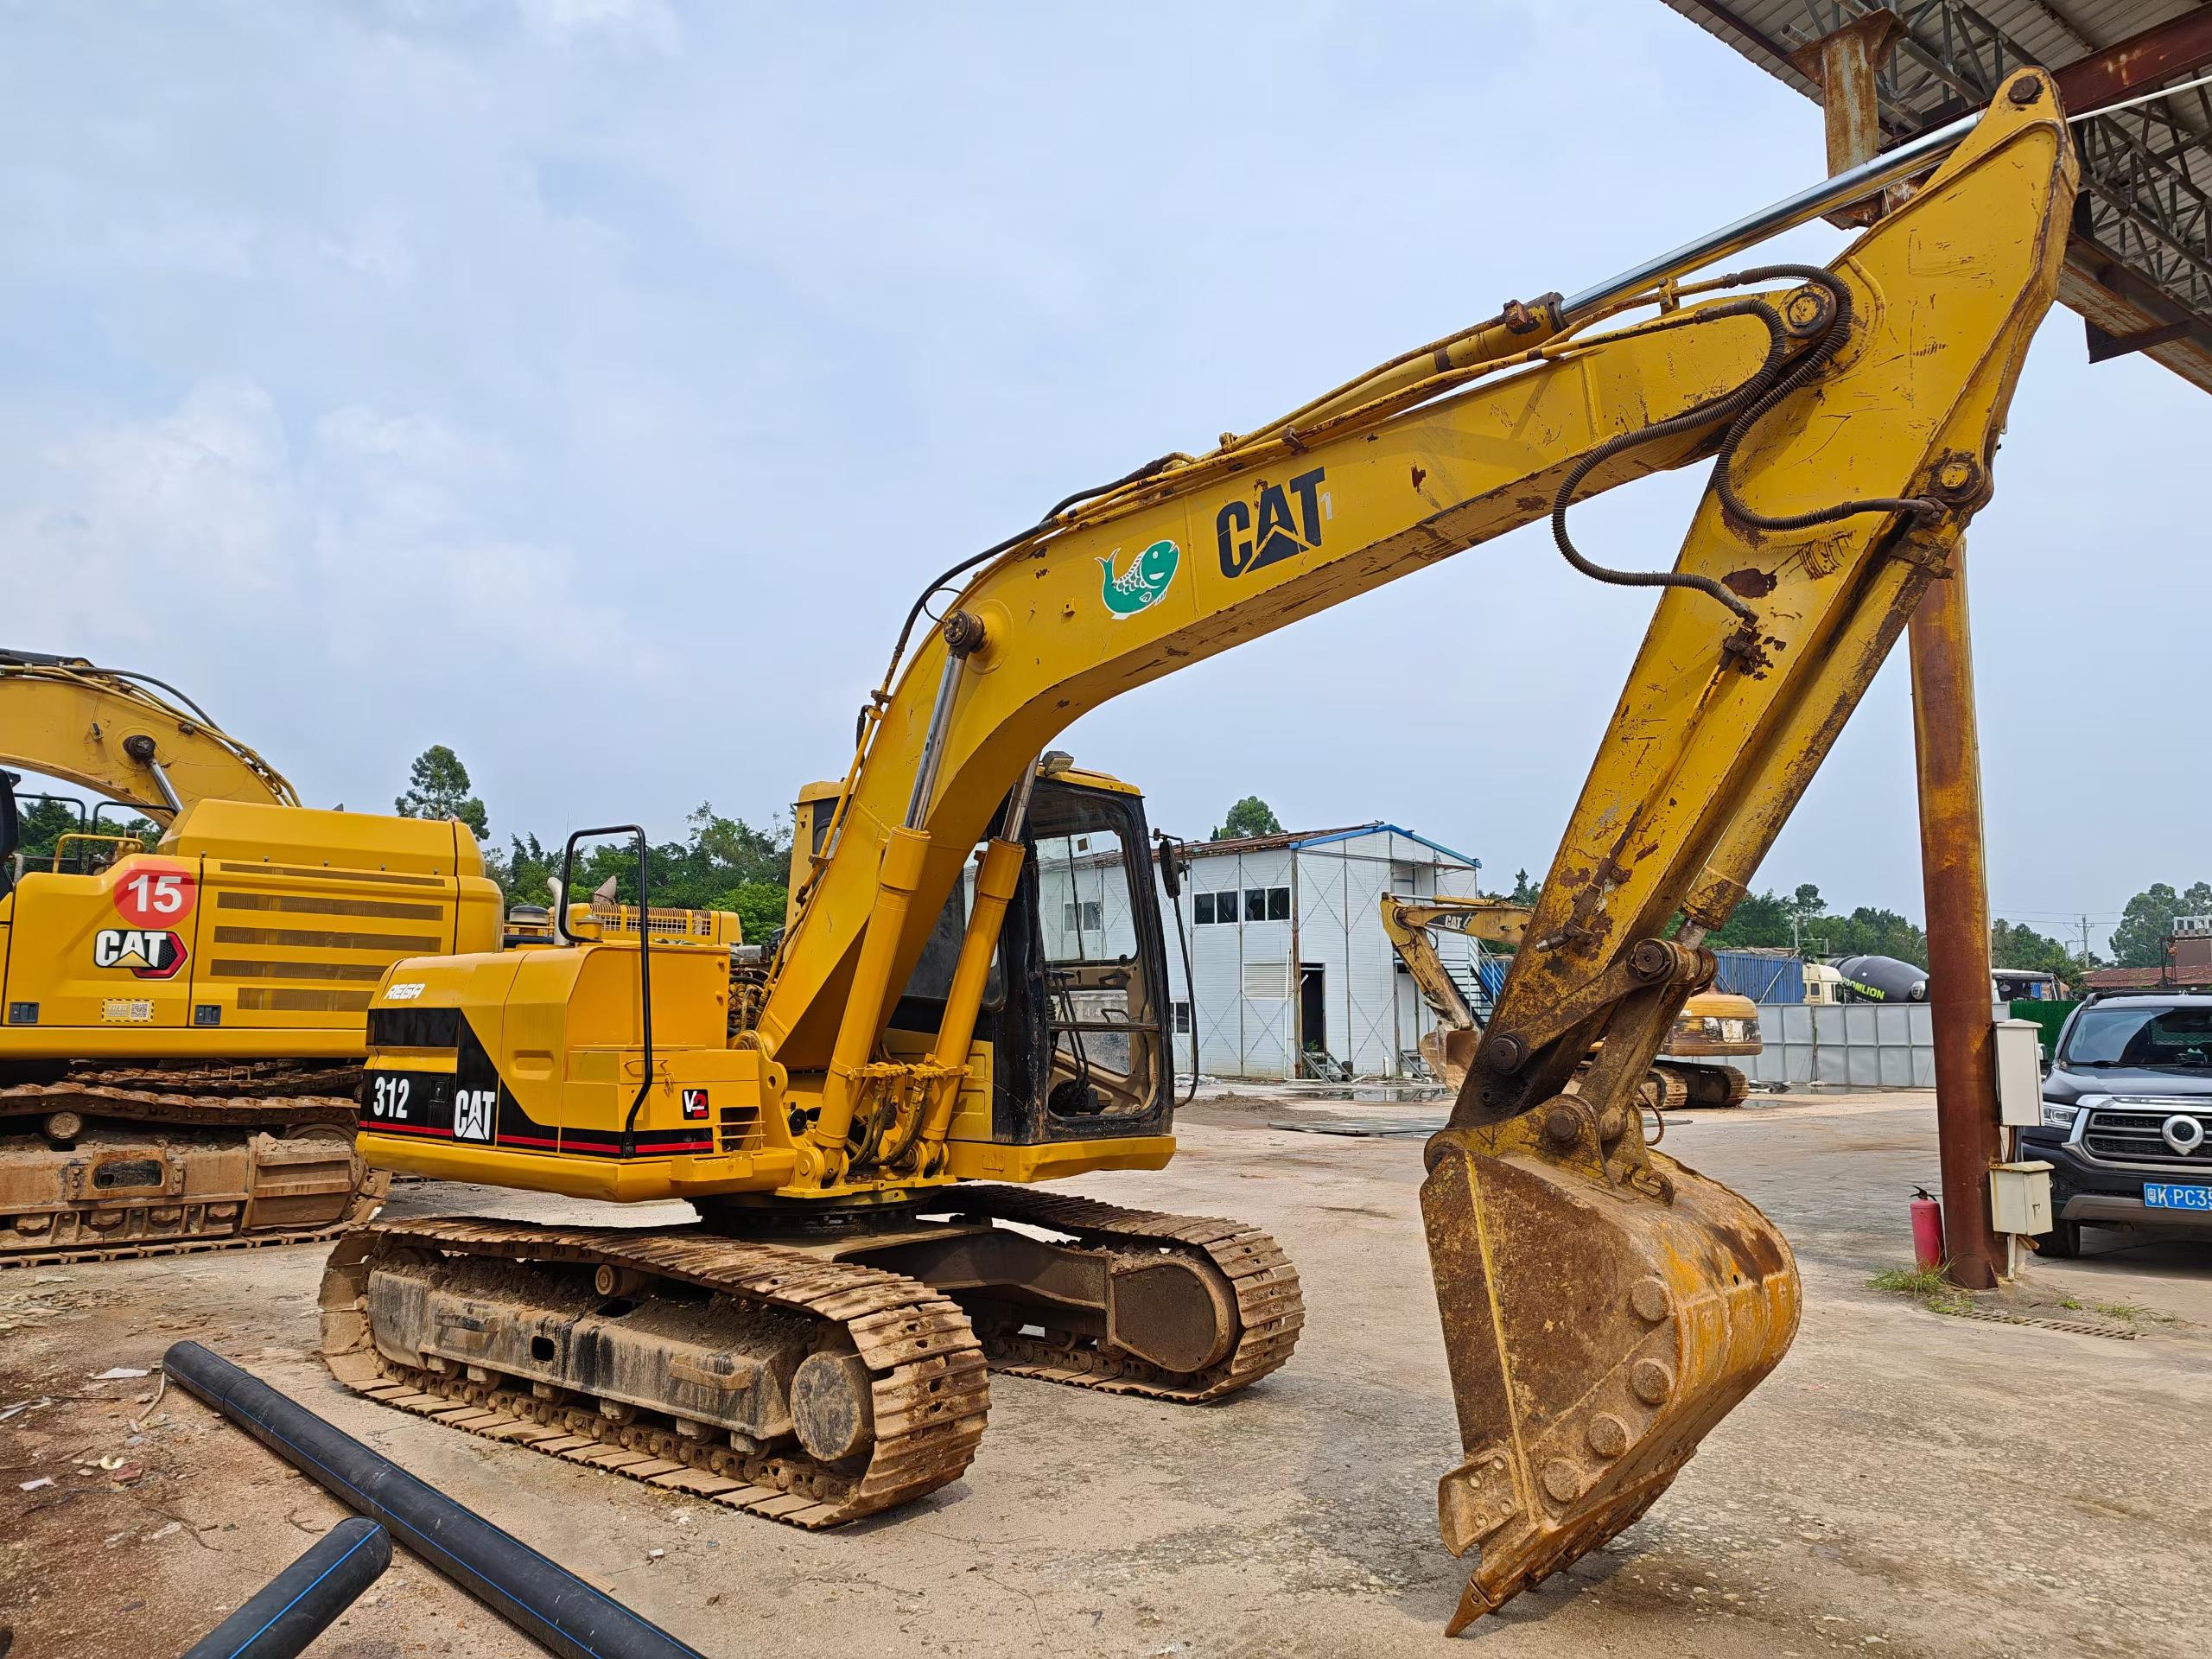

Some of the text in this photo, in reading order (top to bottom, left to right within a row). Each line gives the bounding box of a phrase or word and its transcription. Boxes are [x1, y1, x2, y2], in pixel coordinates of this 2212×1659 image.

[1216, 467, 1325, 578] CAT
[127, 874, 183, 913] 15
[1445, 914, 1463, 931] CAT
[95, 930, 167, 968] CAT
[373, 1076, 410, 1119] 312
[454, 1090, 496, 1141] CAT
